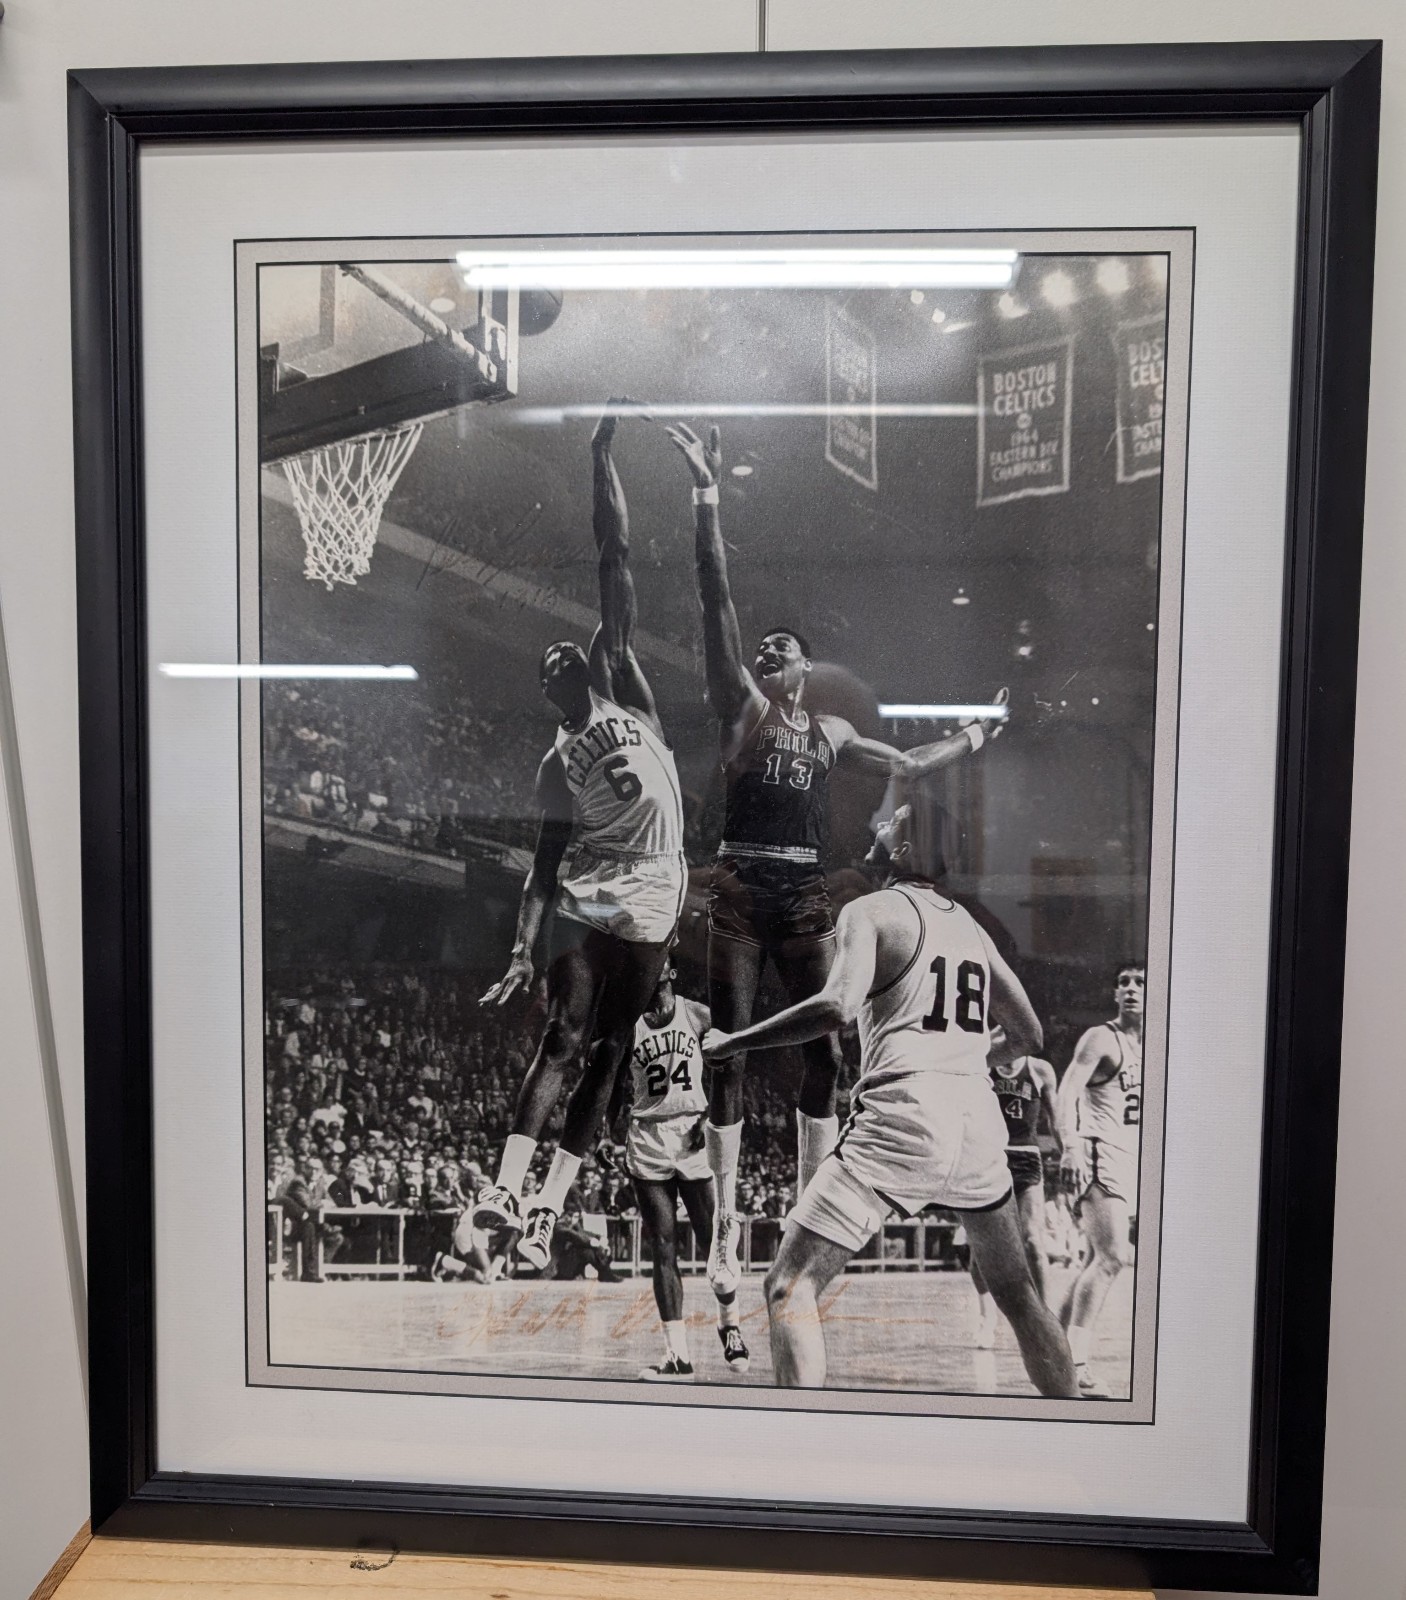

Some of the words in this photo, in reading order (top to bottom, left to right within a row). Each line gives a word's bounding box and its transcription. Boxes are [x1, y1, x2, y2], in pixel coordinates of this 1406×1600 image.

[993, 362, 1056, 394] BOSTON
[993, 384, 1056, 416] CELTICS
[566, 717, 642, 788] CELTICS
[757, 725, 830, 769] PHILA
[604, 757, 643, 801] 6
[763, 754, 814, 791] 13
[922, 955, 985, 1034] 18
[633, 1029, 696, 1068] CELTICS
[645, 1060, 693, 1097] 24
